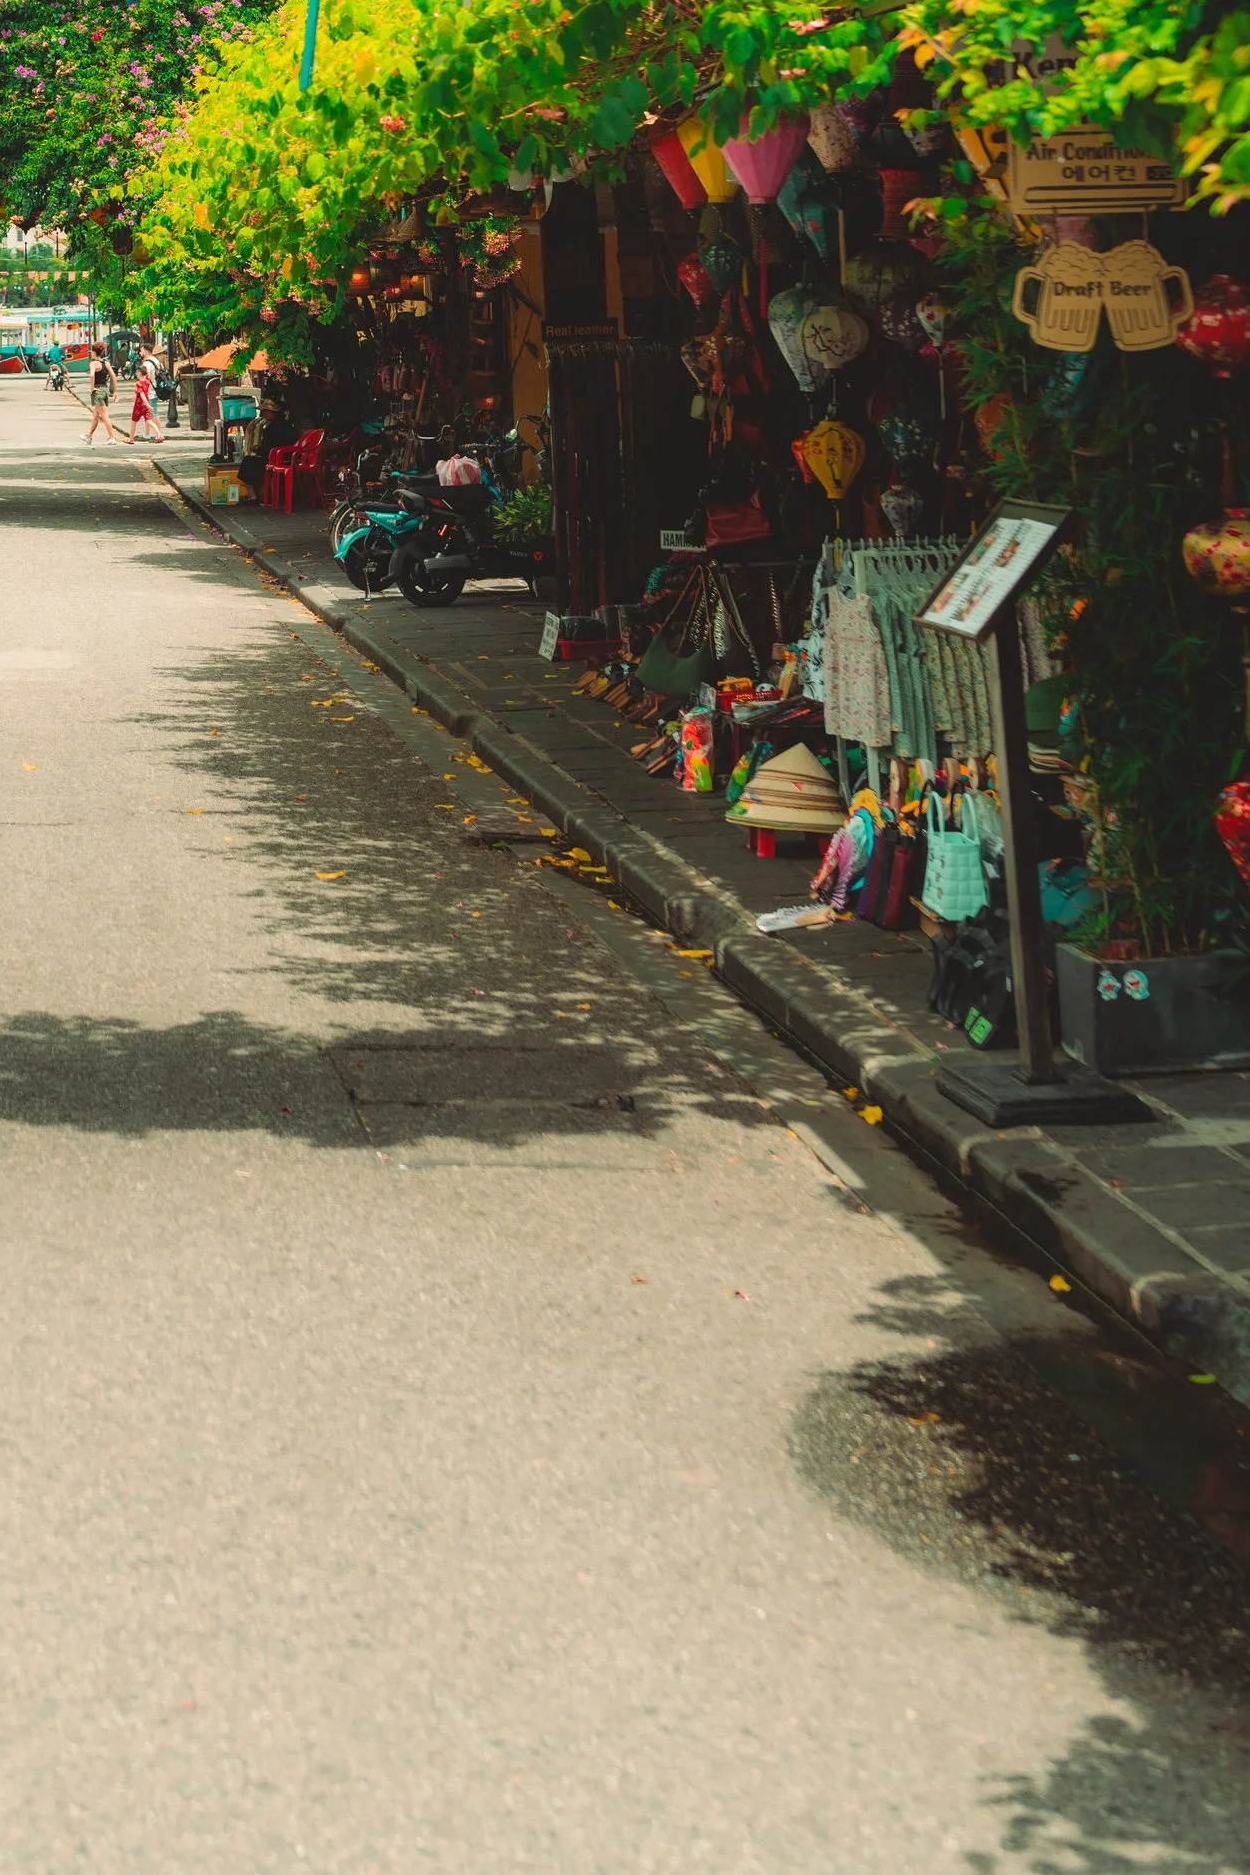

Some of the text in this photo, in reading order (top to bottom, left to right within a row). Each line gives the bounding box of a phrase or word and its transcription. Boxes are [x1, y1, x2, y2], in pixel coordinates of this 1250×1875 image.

[1026, 143, 1057, 161] Air
[1062, 165, 1136, 182] 에어컨
[1053, 281, 1152, 299] Draft Beer
[546, 324, 615, 337] Real leather
